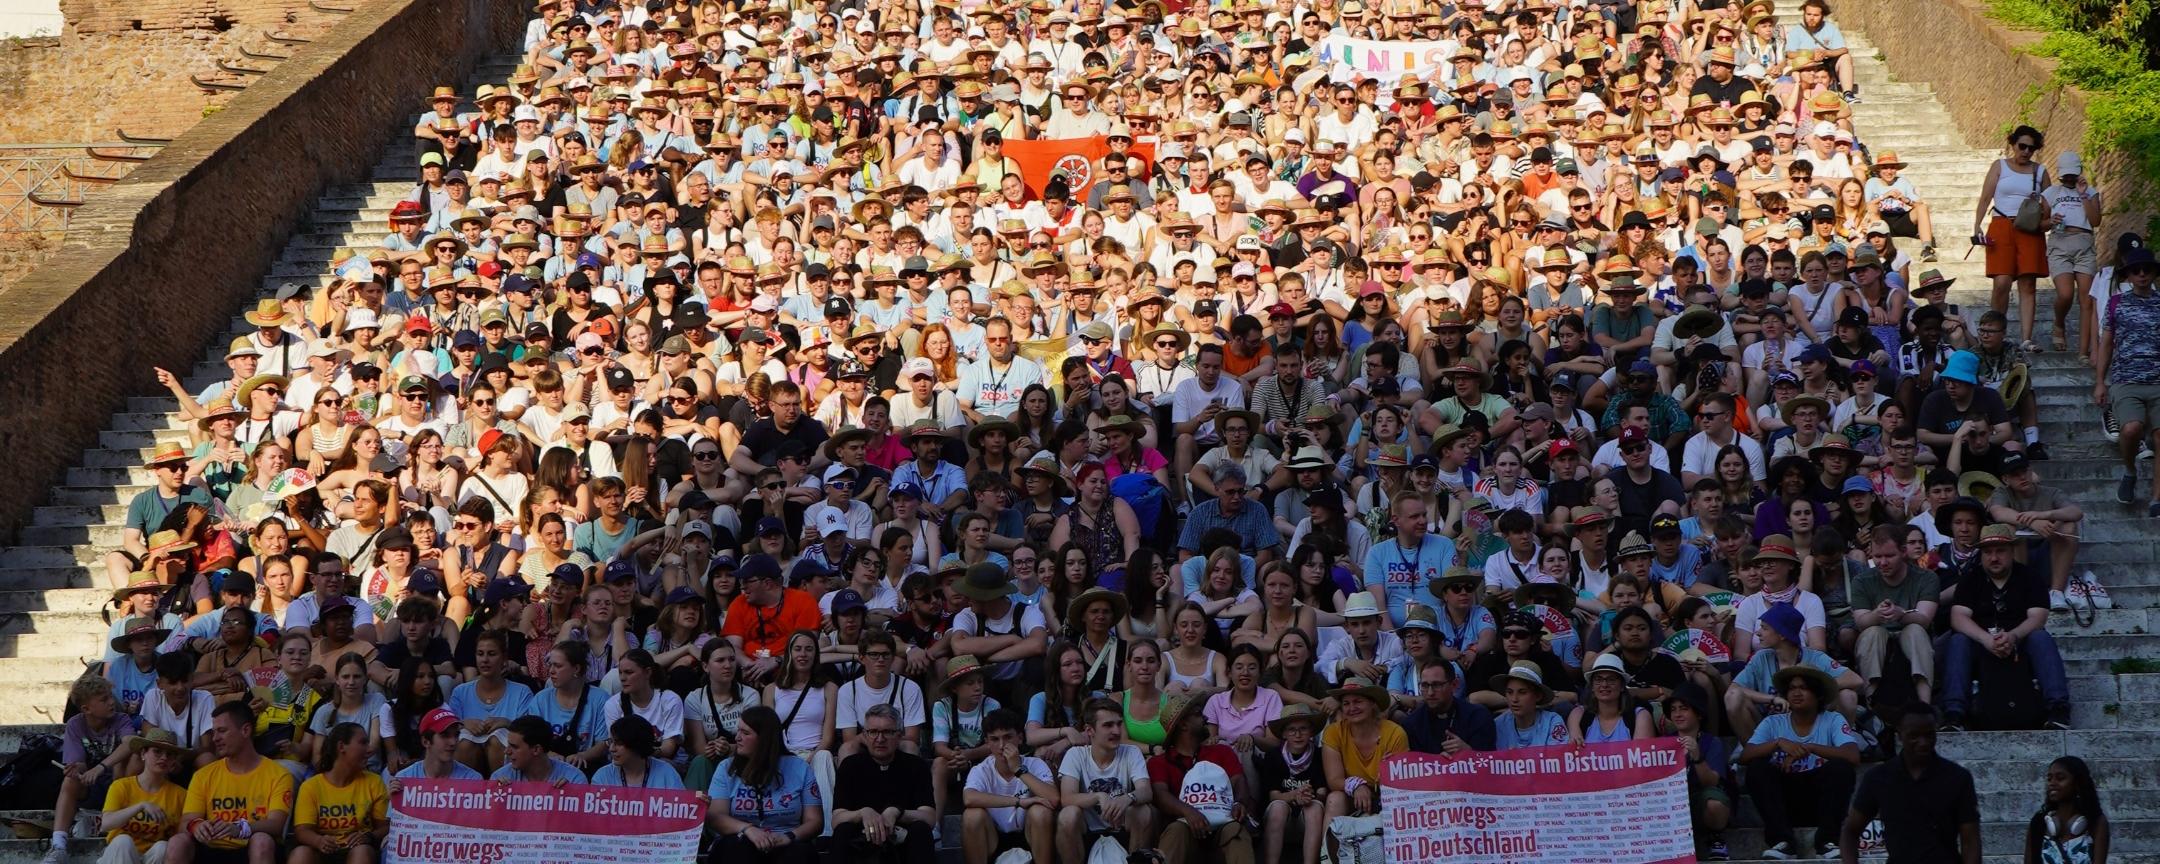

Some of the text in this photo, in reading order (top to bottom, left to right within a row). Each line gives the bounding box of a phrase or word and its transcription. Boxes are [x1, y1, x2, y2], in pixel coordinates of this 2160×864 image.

[1388, 562, 1419, 572] ROM
[1388, 572, 1420, 583] 2024
[1668, 632, 1720, 654] ROM 2024
[1539, 753, 1560, 773] im
[1564, 750, 1624, 773] Bistum
[1628, 745, 1678, 769] Mainz
[212, 797, 246, 810] ROM
[558, 790, 579, 812] im
[584, 792, 644, 816] Bistum
[649, 796, 698, 820] Mainz
[735, 799, 774, 810] 204
[212, 810, 248, 822] 2024
[320, 804, 356, 817] ROM
[320, 817, 359, 830] 2024
[1393, 806, 1497, 831] Unterwegs
[396, 834, 504, 864] Unterwegs
[1396, 829, 1536, 862] in Deutschland
